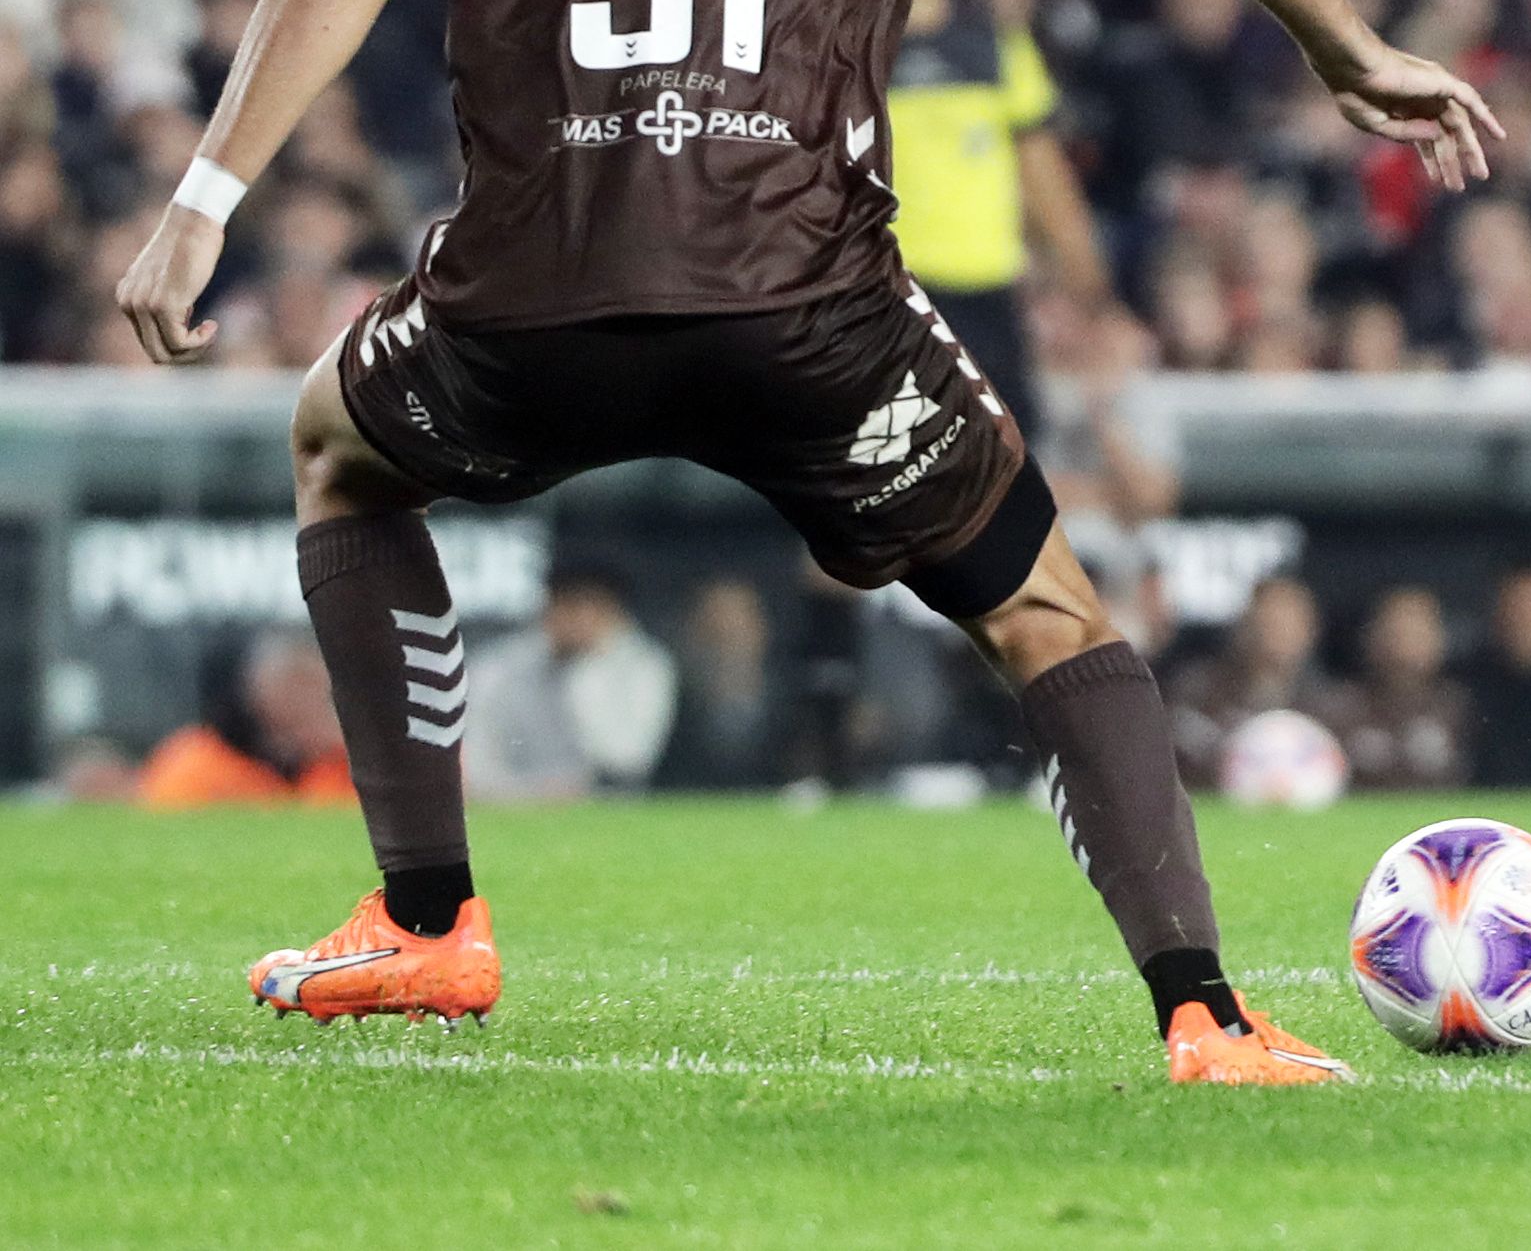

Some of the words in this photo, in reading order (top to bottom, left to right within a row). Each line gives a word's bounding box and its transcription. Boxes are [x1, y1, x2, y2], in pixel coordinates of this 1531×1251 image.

[619, 70, 728, 96] PAPELERA
[561, 115, 624, 142] MAS
[706, 113, 794, 141] PACK
